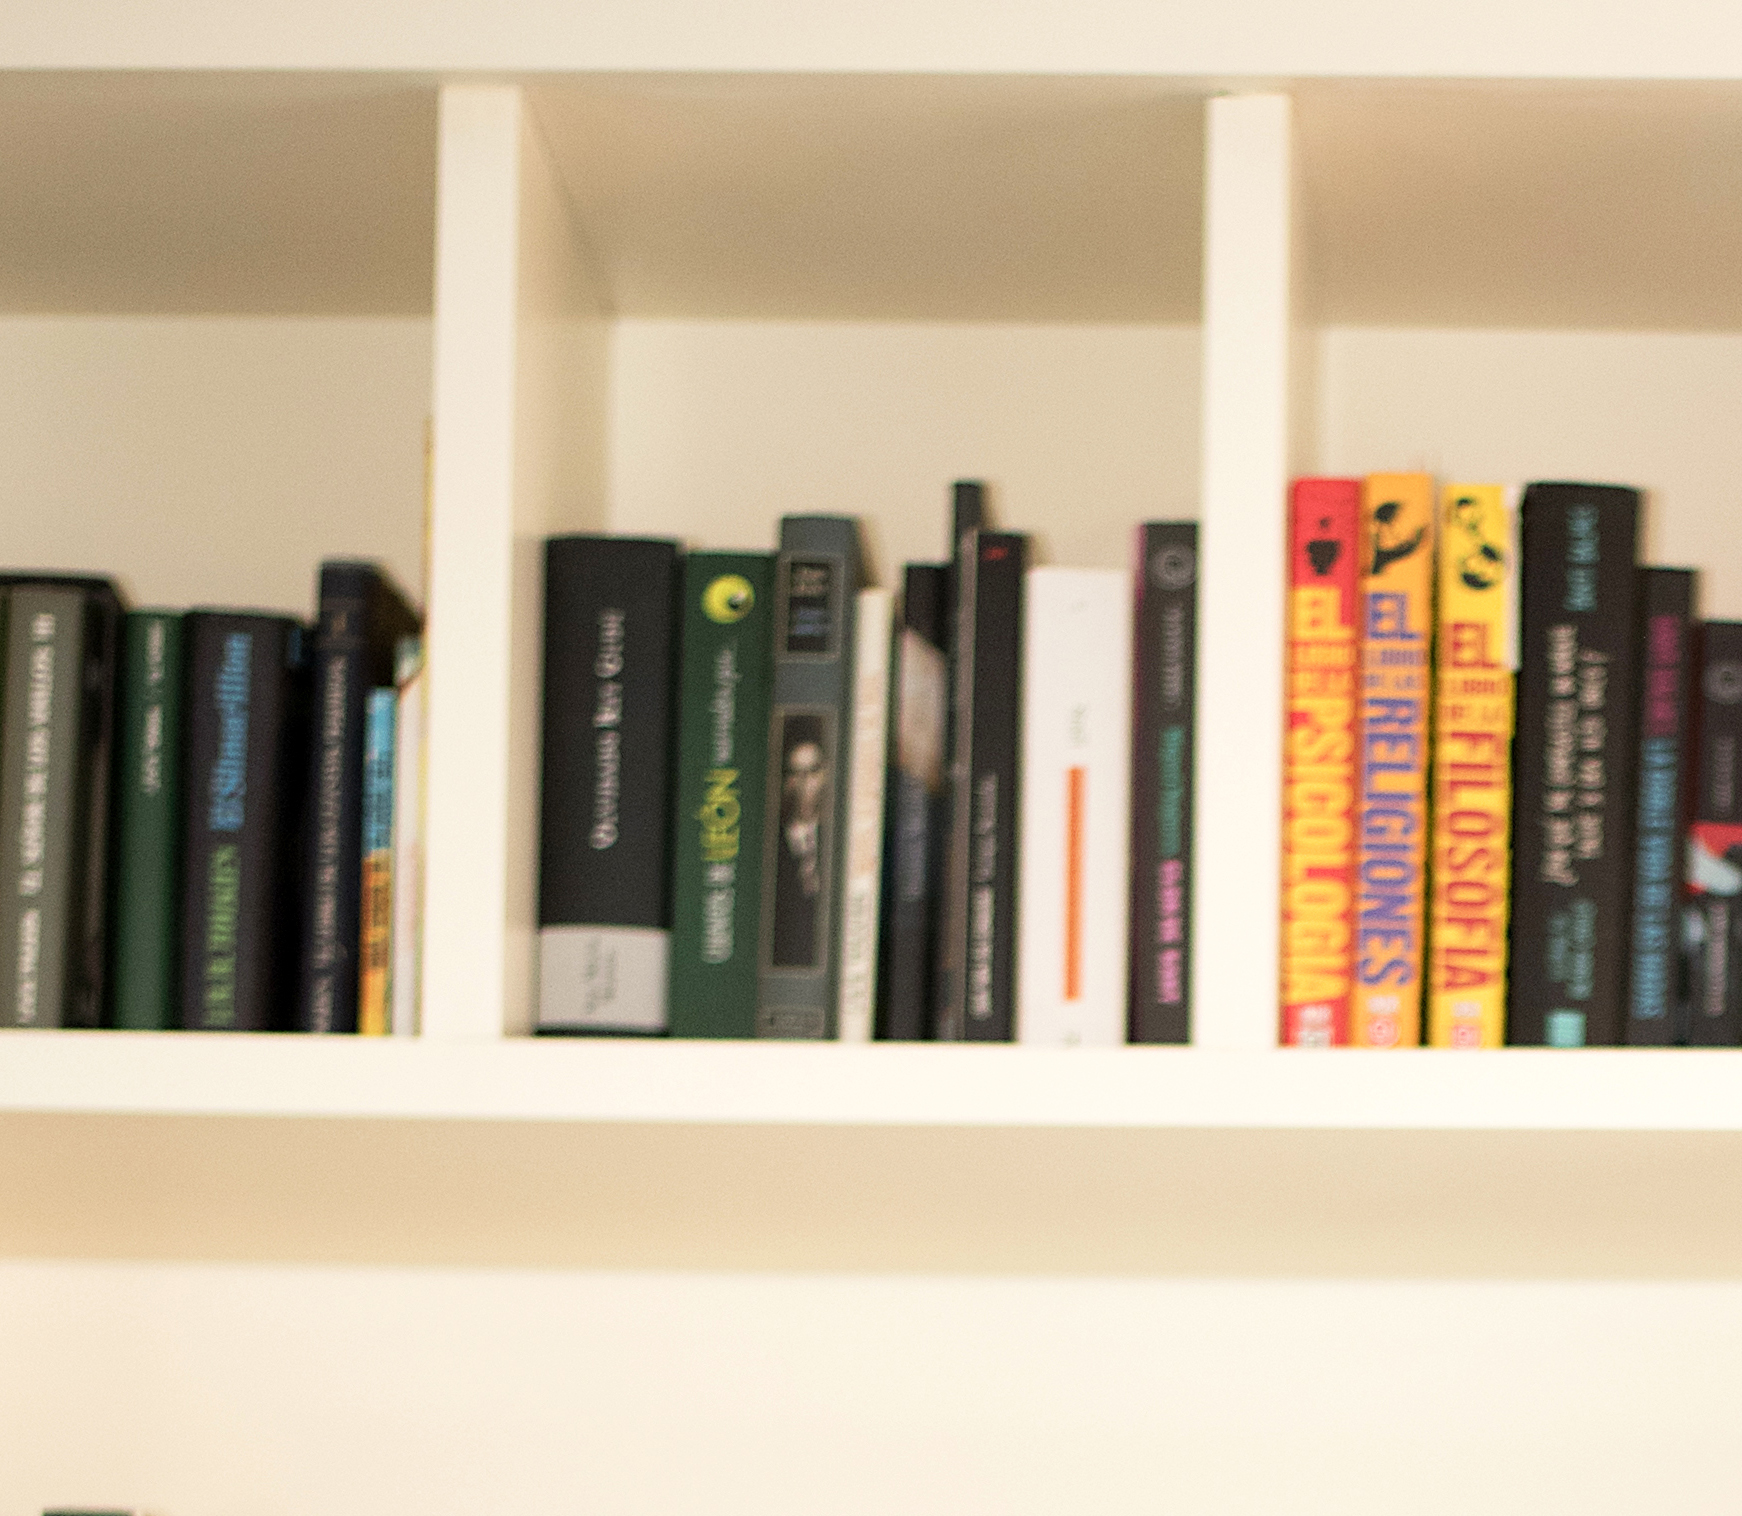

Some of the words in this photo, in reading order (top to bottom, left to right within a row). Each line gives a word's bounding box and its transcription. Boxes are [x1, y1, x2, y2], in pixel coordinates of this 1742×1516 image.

[695, 768, 741, 861] LEÓN
[1359, 697, 1418, 987] RELIGIONES
[1444, 731, 1497, 990] FILOSOFIA
